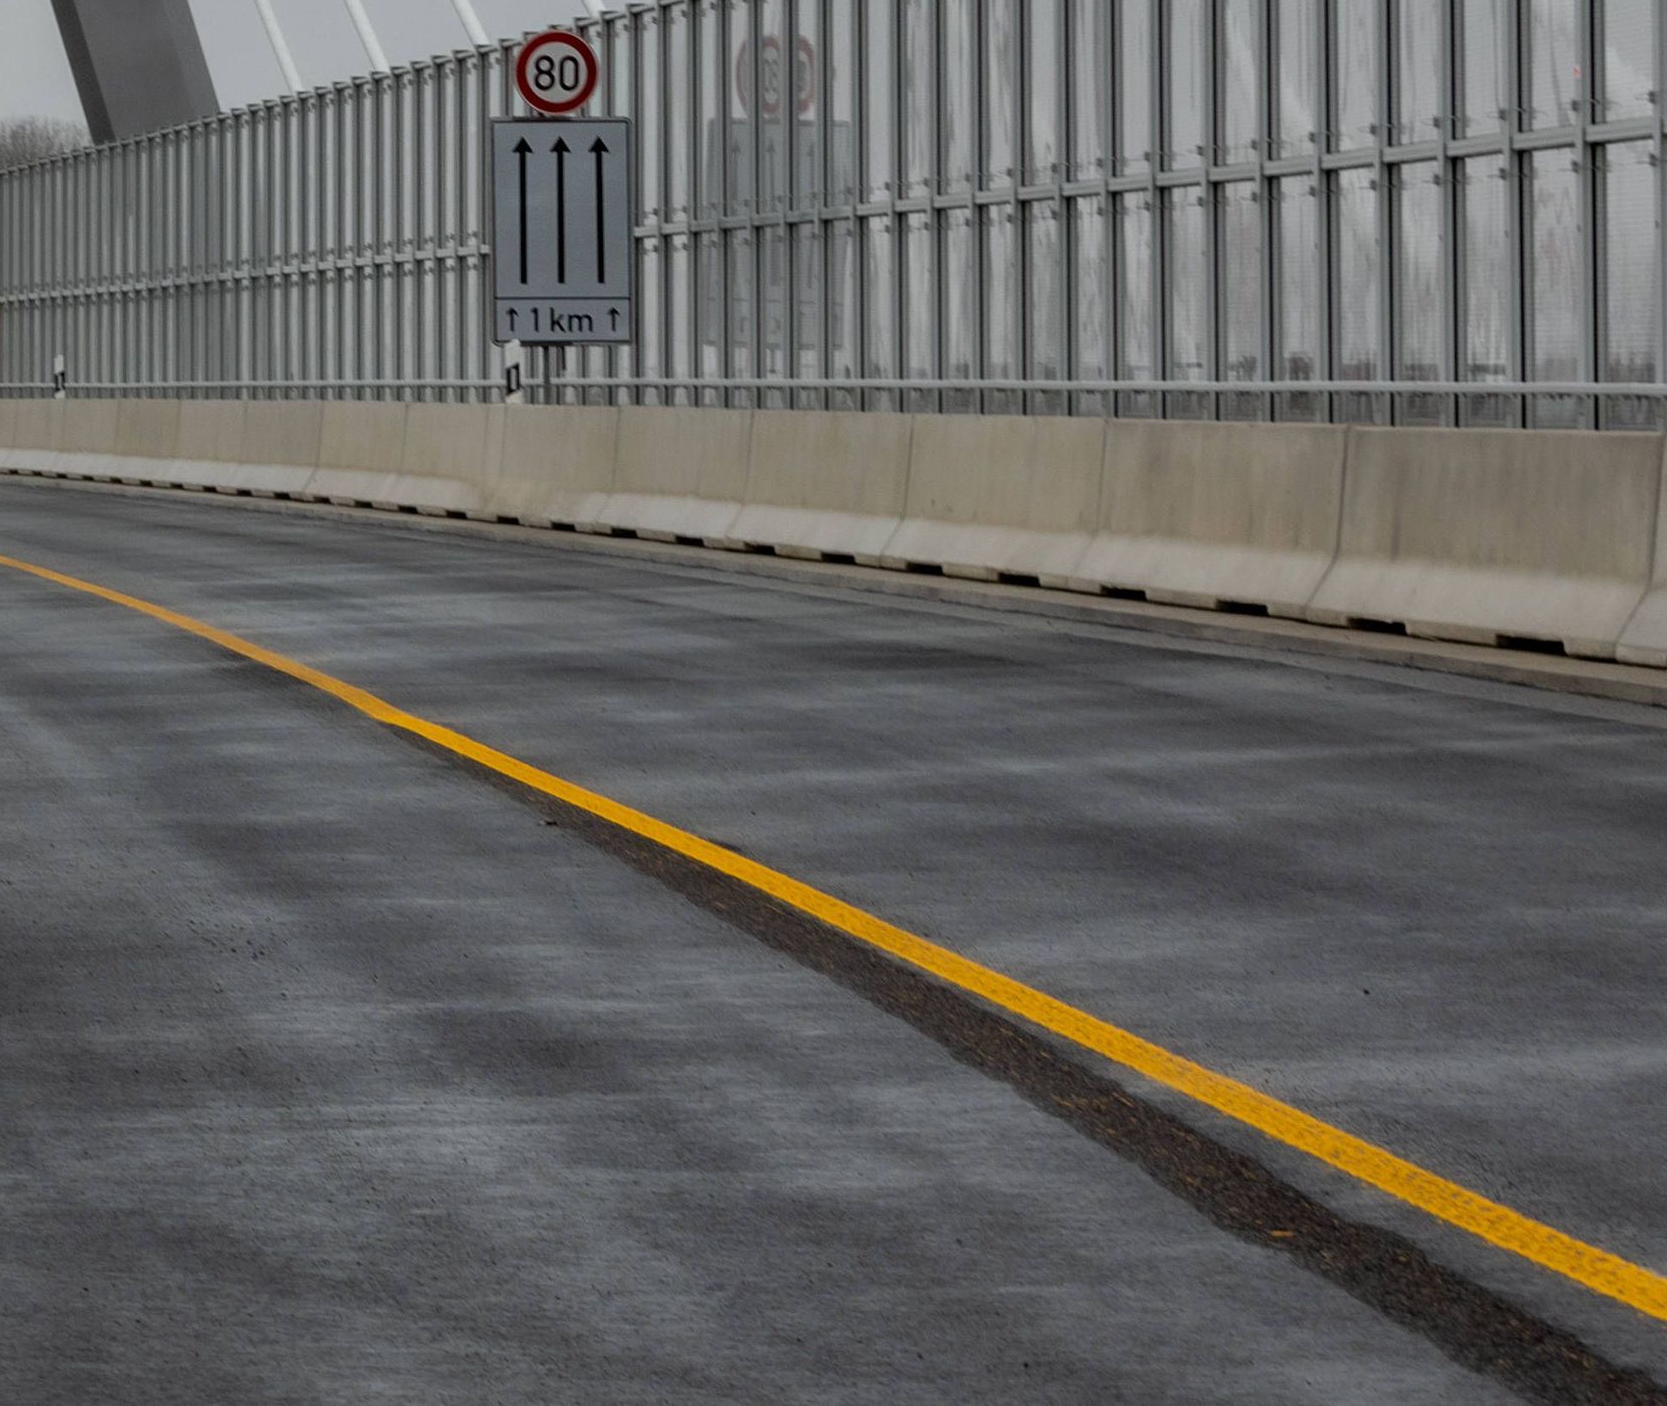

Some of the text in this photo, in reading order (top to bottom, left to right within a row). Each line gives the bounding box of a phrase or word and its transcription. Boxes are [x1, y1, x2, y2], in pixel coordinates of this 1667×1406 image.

[535, 55, 580, 92] 80
[530, 307, 593, 333] 1 km
